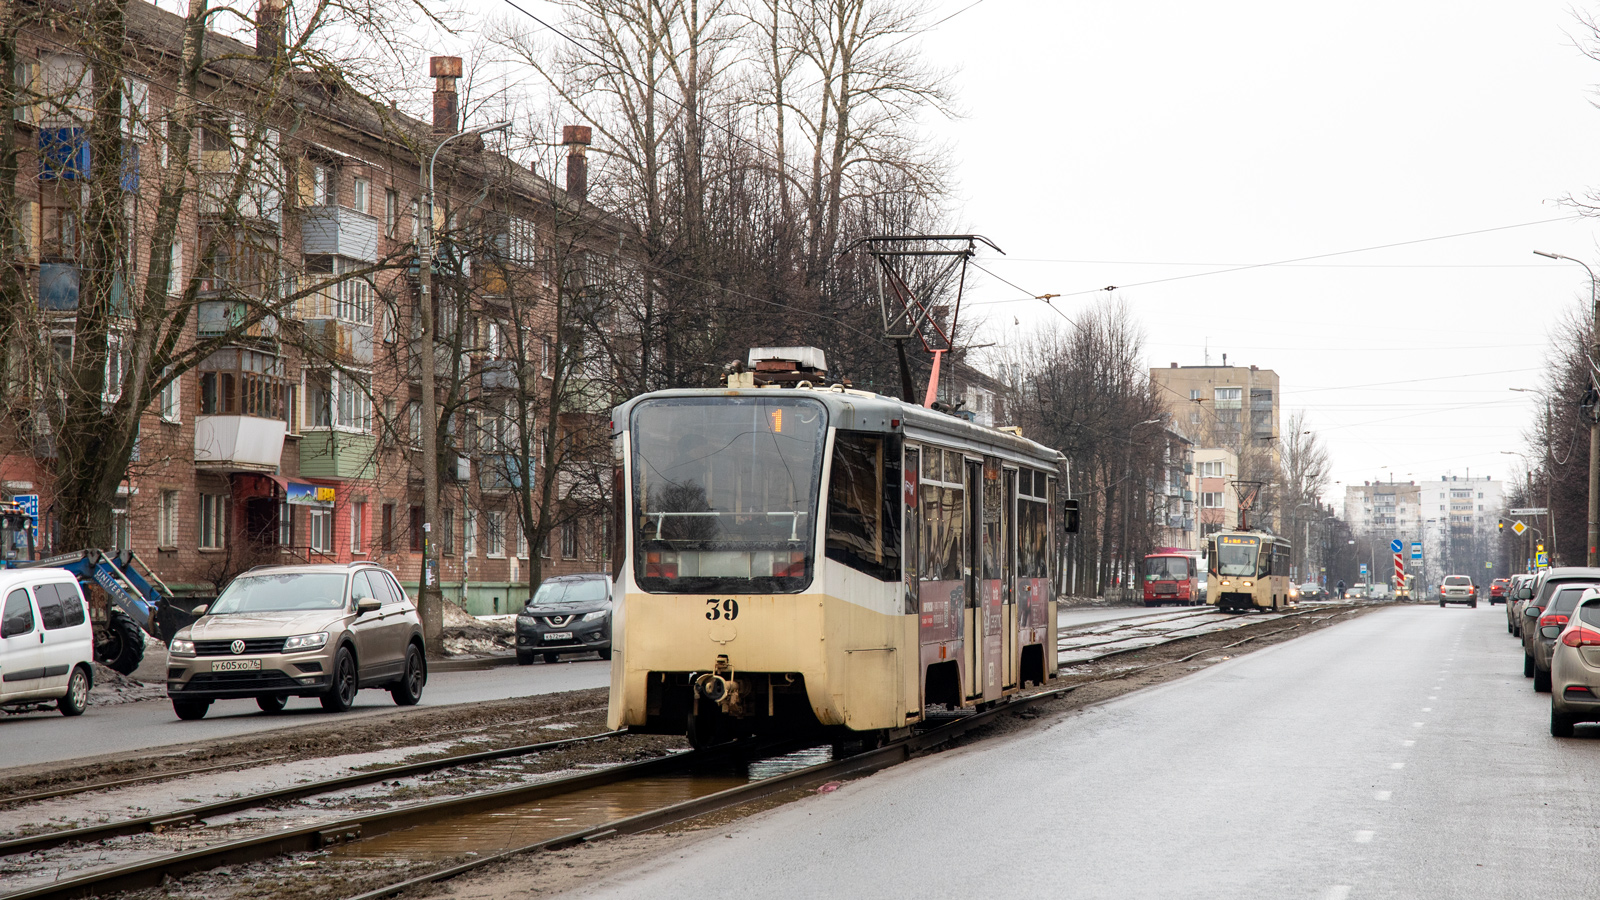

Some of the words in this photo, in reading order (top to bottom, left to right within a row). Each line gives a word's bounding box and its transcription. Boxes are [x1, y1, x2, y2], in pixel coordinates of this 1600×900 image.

[772, 409, 782, 432] 1
[96, 568, 132, 608] UNIVERSAL
[705, 598, 739, 621] 39
[249, 659, 258, 667] 76
